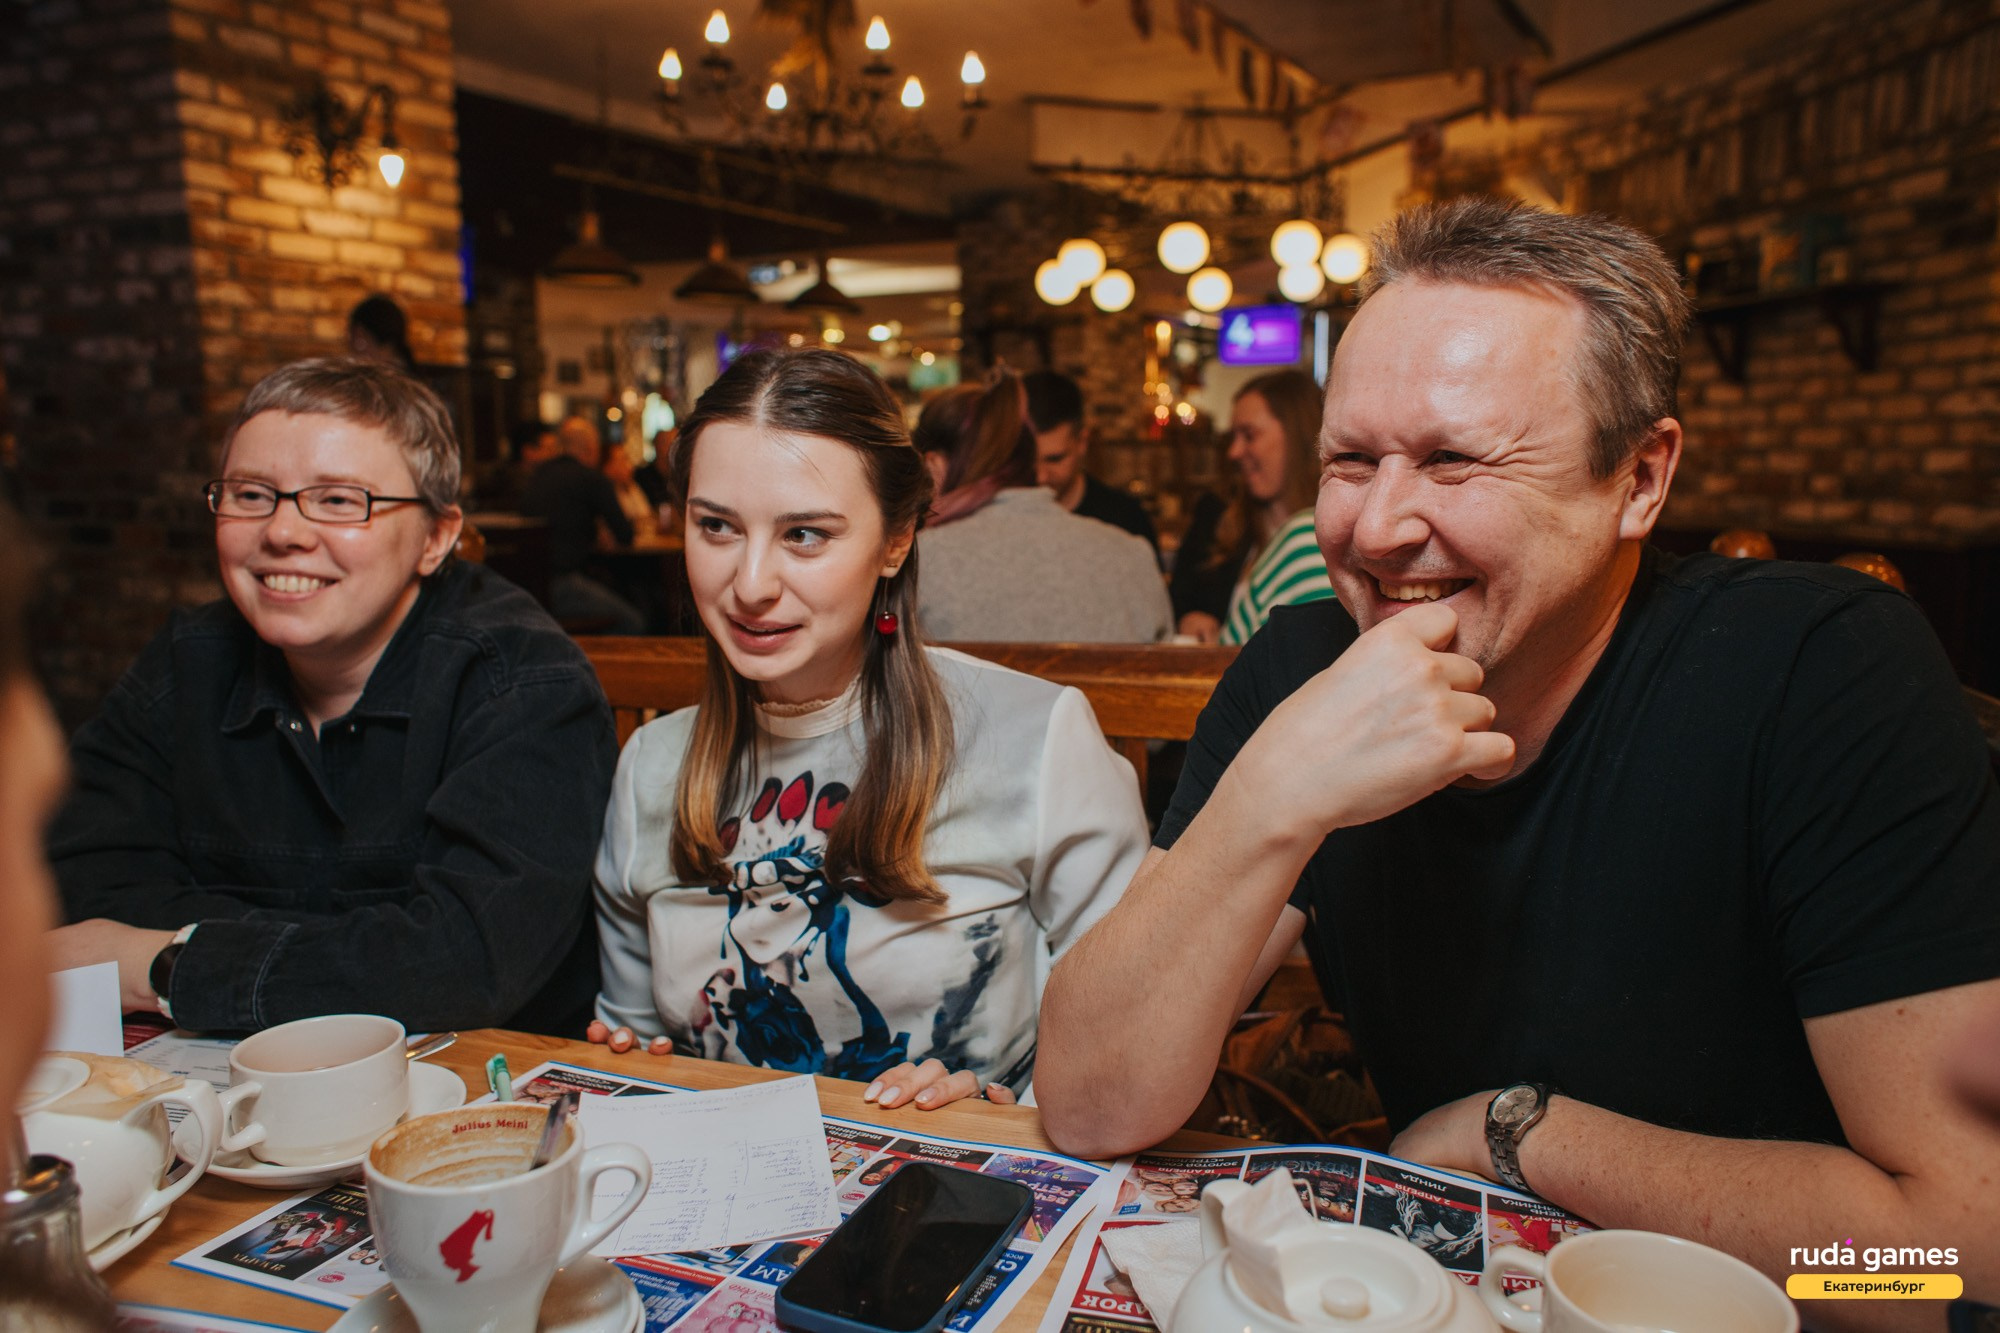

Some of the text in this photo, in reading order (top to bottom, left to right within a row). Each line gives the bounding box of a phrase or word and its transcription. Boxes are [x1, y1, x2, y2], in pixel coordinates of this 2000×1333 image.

[452, 1119, 528, 1134] Julius Meinl
[918, 1143, 971, 1156] КОРОВКА
[919, 1147, 960, 1159] БОЖЬЯ
[1185, 1160, 1238, 1168] ЗОЛОТОЙ
[1008, 1166, 1048, 1178] МАРТА
[1158, 1167, 1202, 1175] АПРЕЛЯ
[1400, 1172, 1448, 1192] ЛИНДА
[1394, 1183, 1444, 1204] АПРЕЛЯ
[1530, 1208, 1566, 1218] ДЕНЬ
[1519, 1214, 1563, 1225] МАРТА
[1080, 1293, 1147, 1314] АРОК
